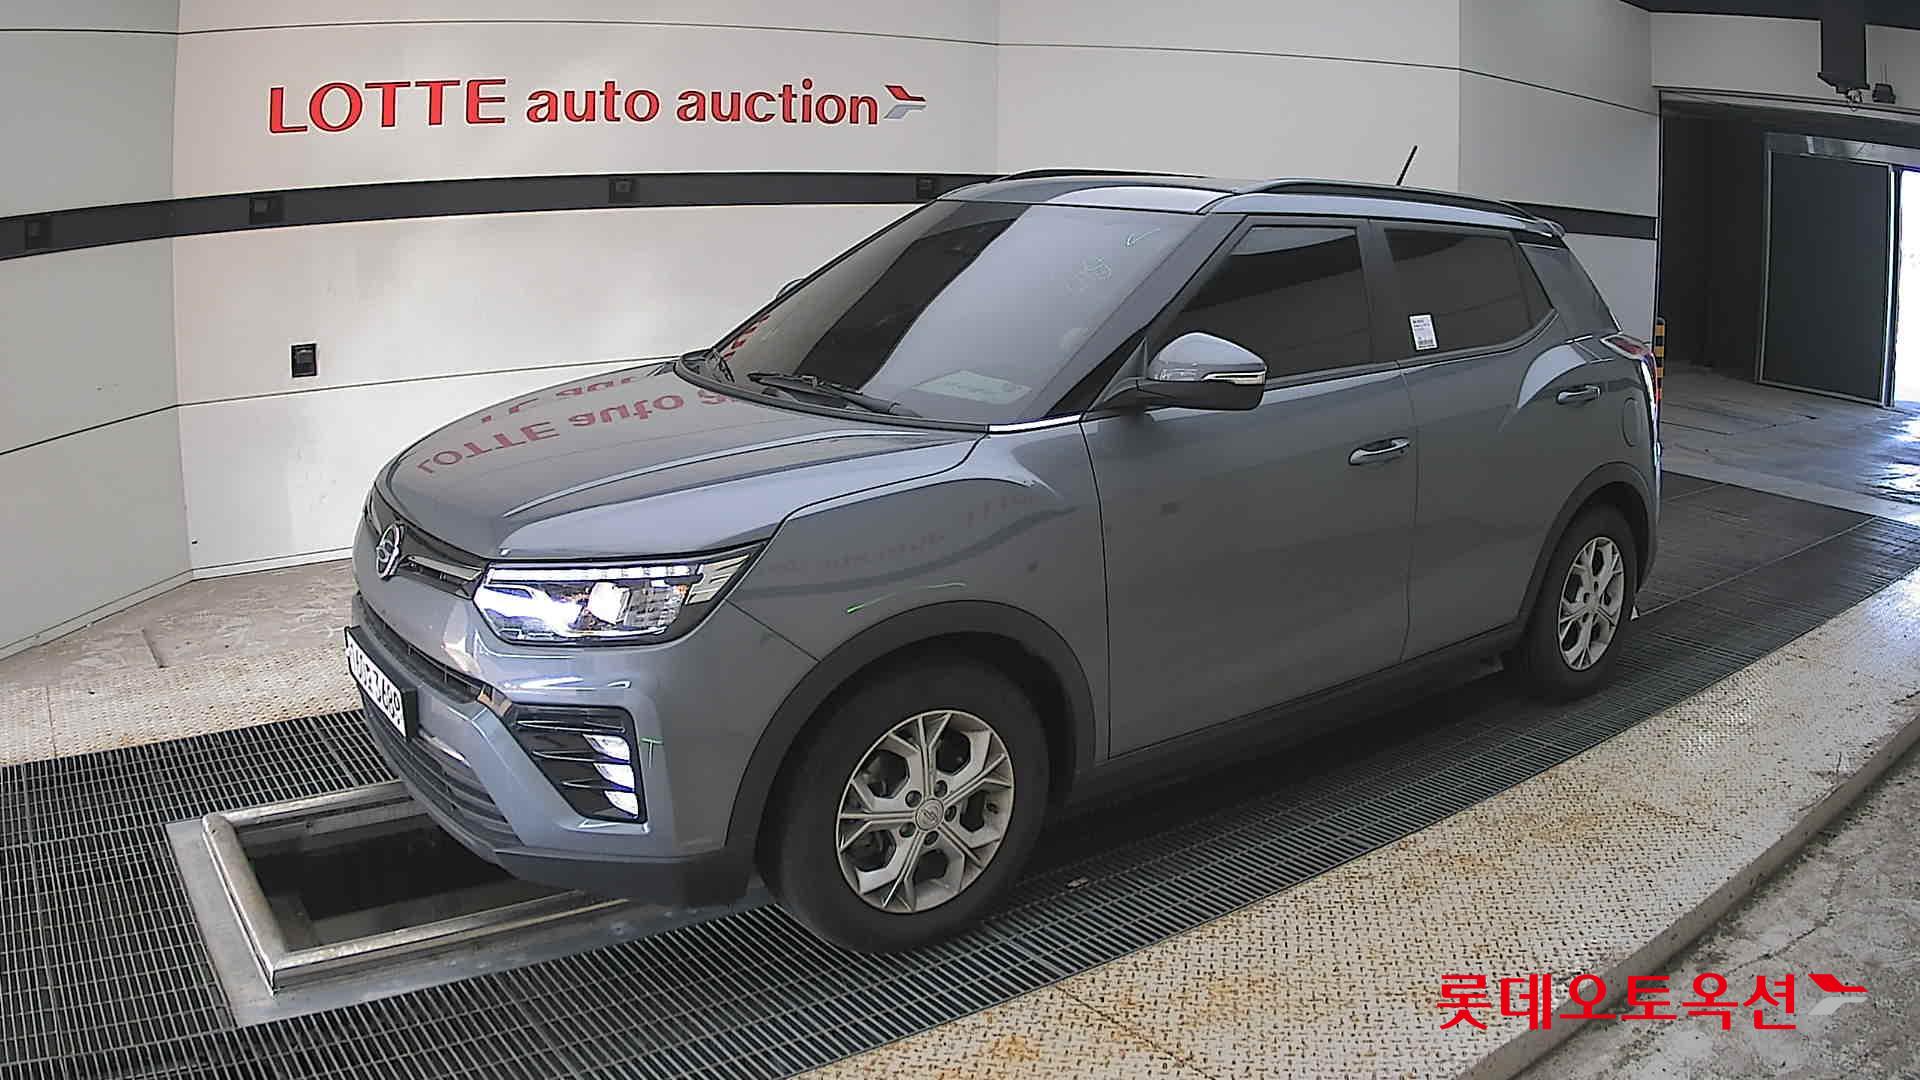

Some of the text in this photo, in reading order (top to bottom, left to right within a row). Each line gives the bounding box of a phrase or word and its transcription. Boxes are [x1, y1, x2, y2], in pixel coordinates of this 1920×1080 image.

[269, 78, 879, 133] LOTTE auto auction
